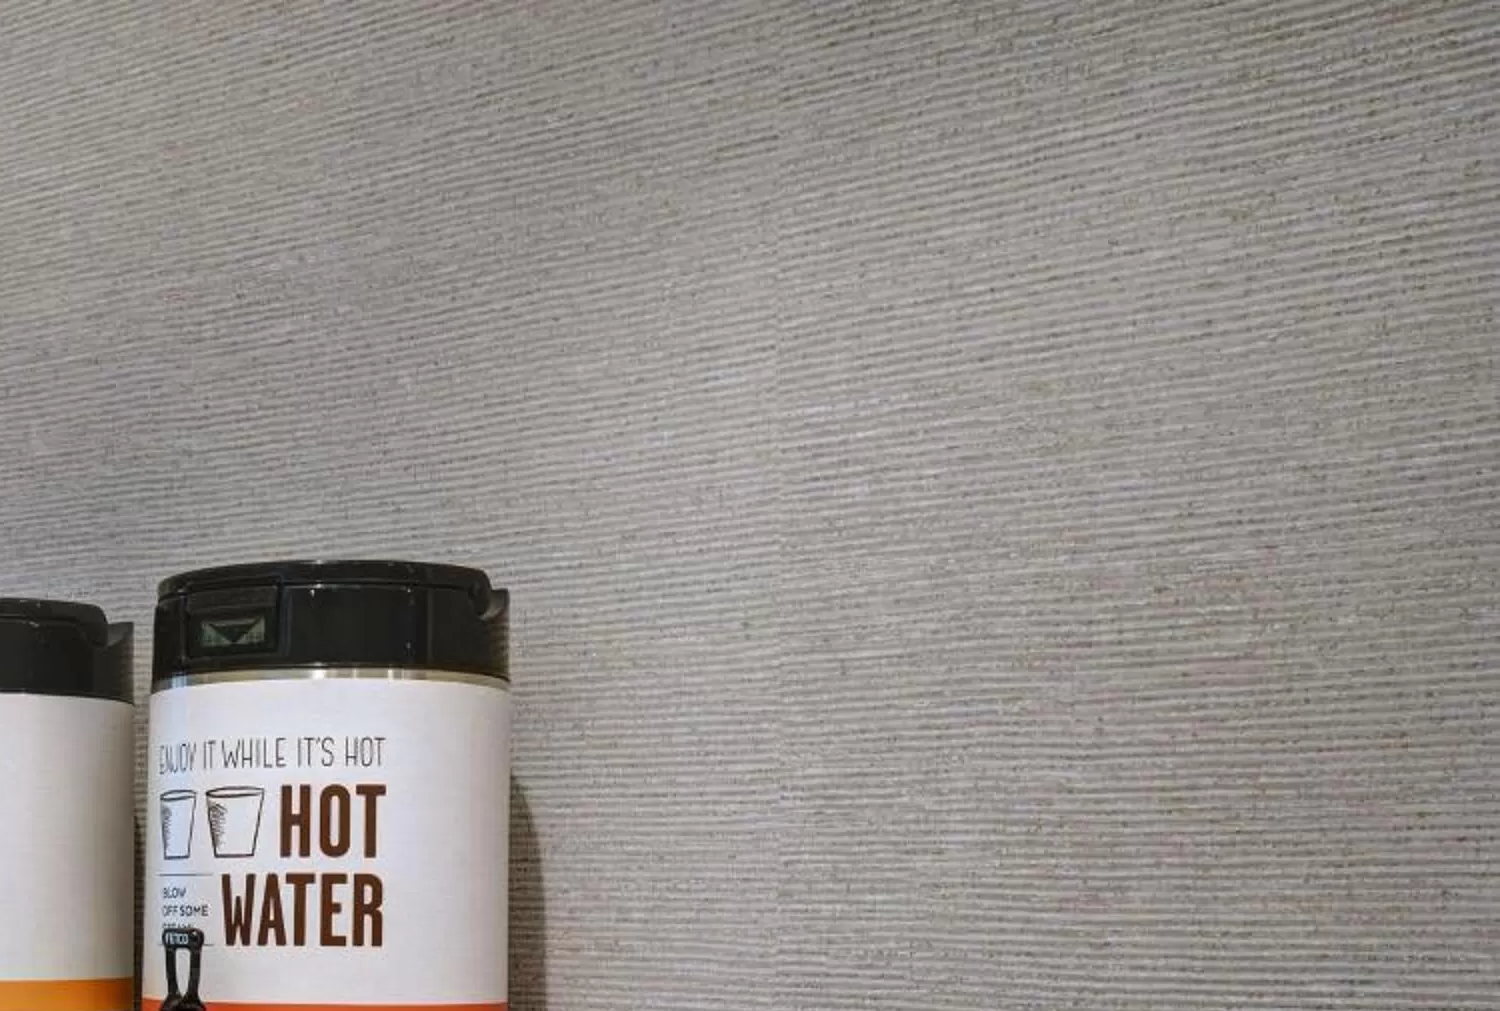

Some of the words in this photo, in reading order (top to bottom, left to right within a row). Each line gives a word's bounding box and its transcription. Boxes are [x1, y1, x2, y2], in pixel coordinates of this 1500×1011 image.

[159, 742, 196, 775] ENJOY
[203, 739, 216, 769] IT
[221, 737, 286, 769] WHILE
[298, 736, 334, 767] IT'S
[345, 736, 386, 768] HOT
[279, 783, 388, 859] HOT
[162, 905, 178, 918] OFF
[180, 905, 209, 917] SOME
[163, 887, 187, 899] BLOW
[220, 872, 384, 948] WATER
